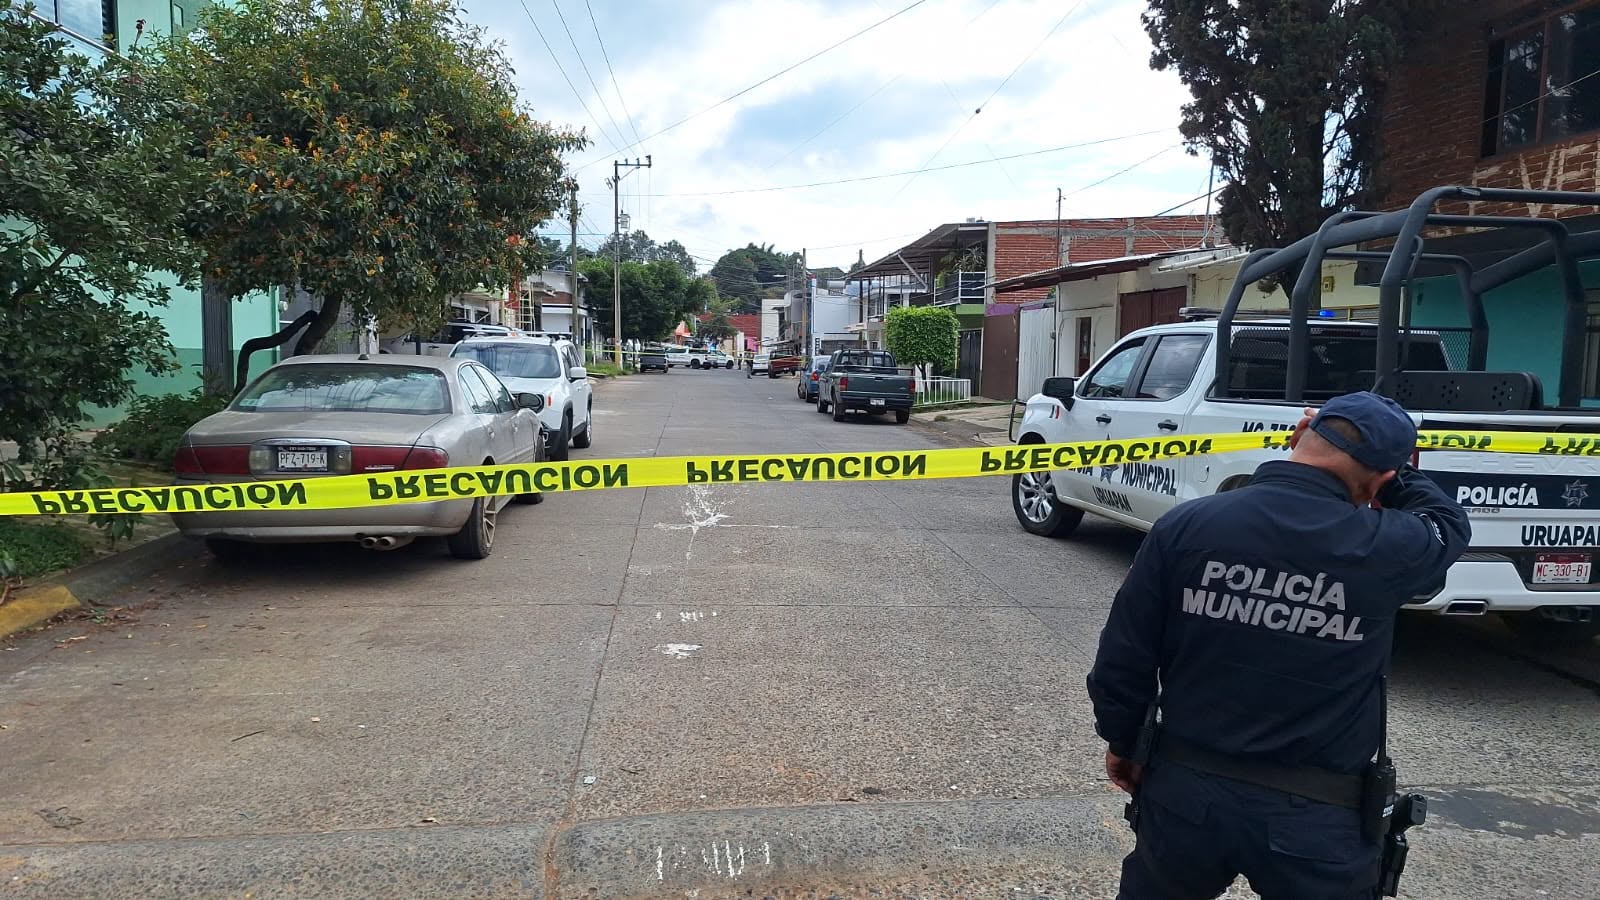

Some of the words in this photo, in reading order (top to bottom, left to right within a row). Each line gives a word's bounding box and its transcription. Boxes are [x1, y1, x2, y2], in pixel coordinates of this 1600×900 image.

[1121, 463, 1177, 496] MUNICIPAL
[1456, 483, 1540, 507] POLICÍA
[1520, 525, 1600, 547] URUAPA
[1536, 564, 1589, 577] MC-330-B1
[1201, 560, 1346, 611] POLICÍA
[1182, 587, 1364, 641] MUNICIPAL
